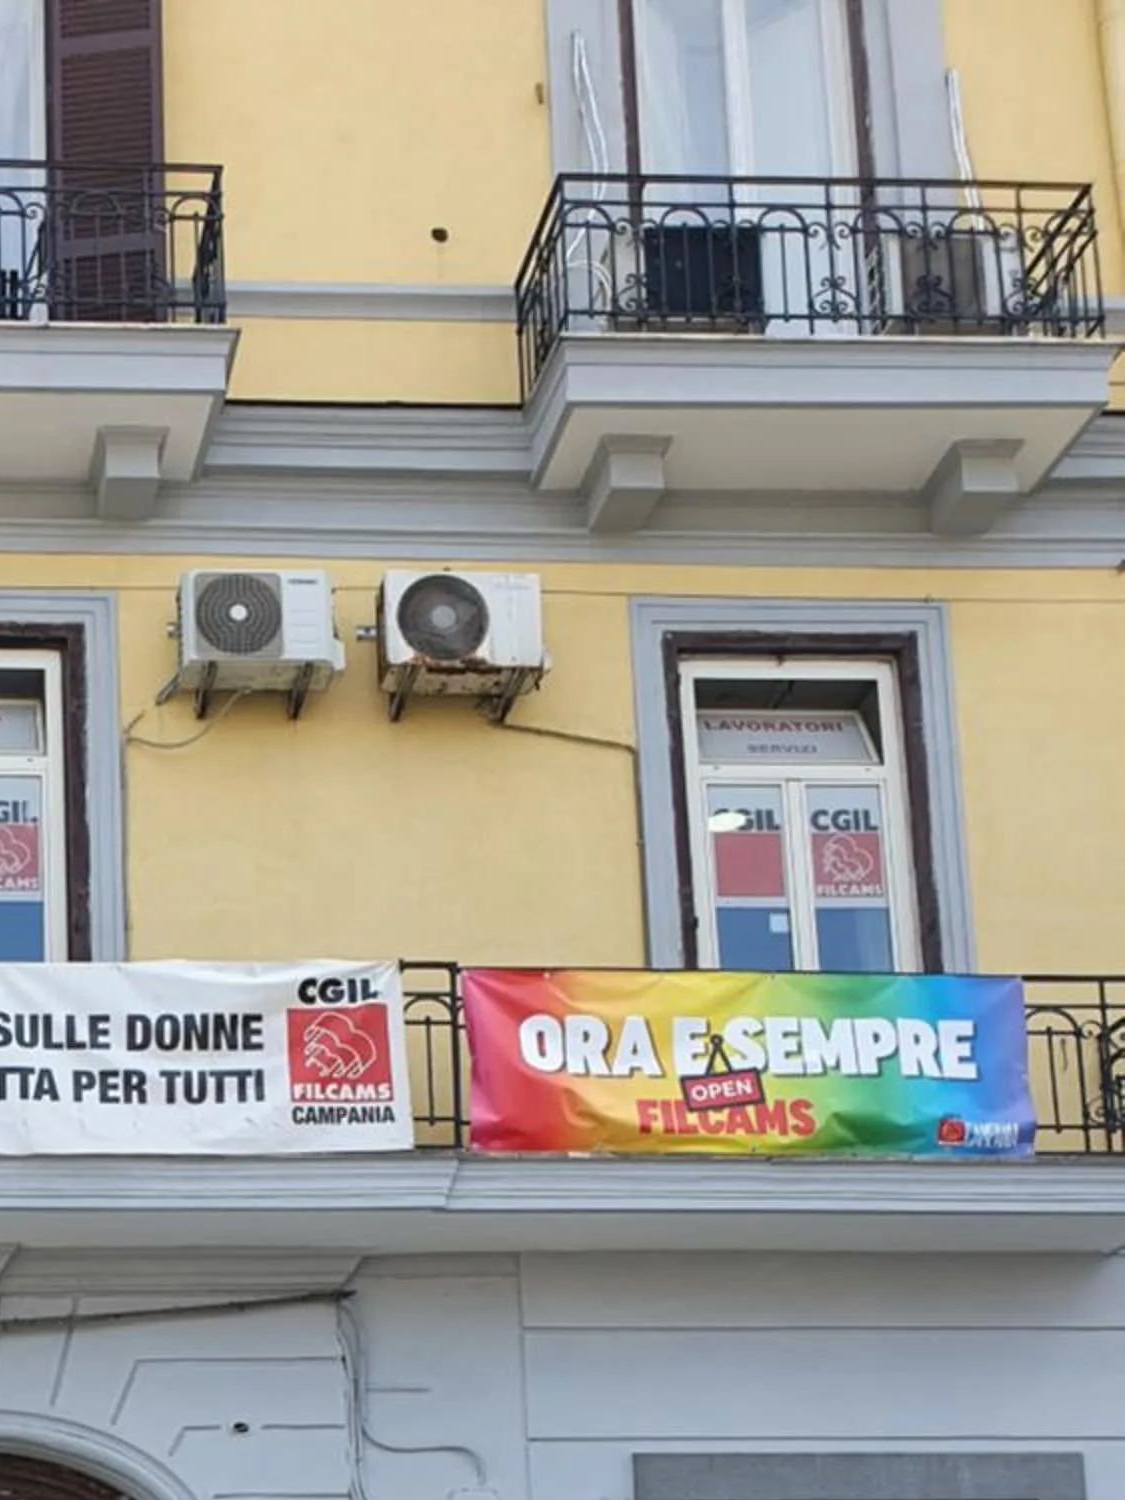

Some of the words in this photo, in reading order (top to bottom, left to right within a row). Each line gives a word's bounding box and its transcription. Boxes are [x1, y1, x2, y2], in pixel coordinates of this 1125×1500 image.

[703, 720, 843, 732] LAVORATORI
[810, 808, 879, 831] CGIL
[816, 884, 884, 895] FILCAMS
[298, 977, 380, 1005] CGIL
[126, 1014, 265, 1051] DONNE
[518, 1012, 665, 1078] ORA
[672, 1015, 709, 1076] E
[722, 1015, 980, 1080] SEMPRE
[72, 1069, 148, 1105] PER
[159, 1069, 266, 1105] TUTTI
[293, 1082, 392, 1101] FILCAMS
[690, 1077, 753, 1103] OPEN
[292, 1105, 396, 1125] CAMPANIA
[636, 1099, 816, 1138] FILCAMS
